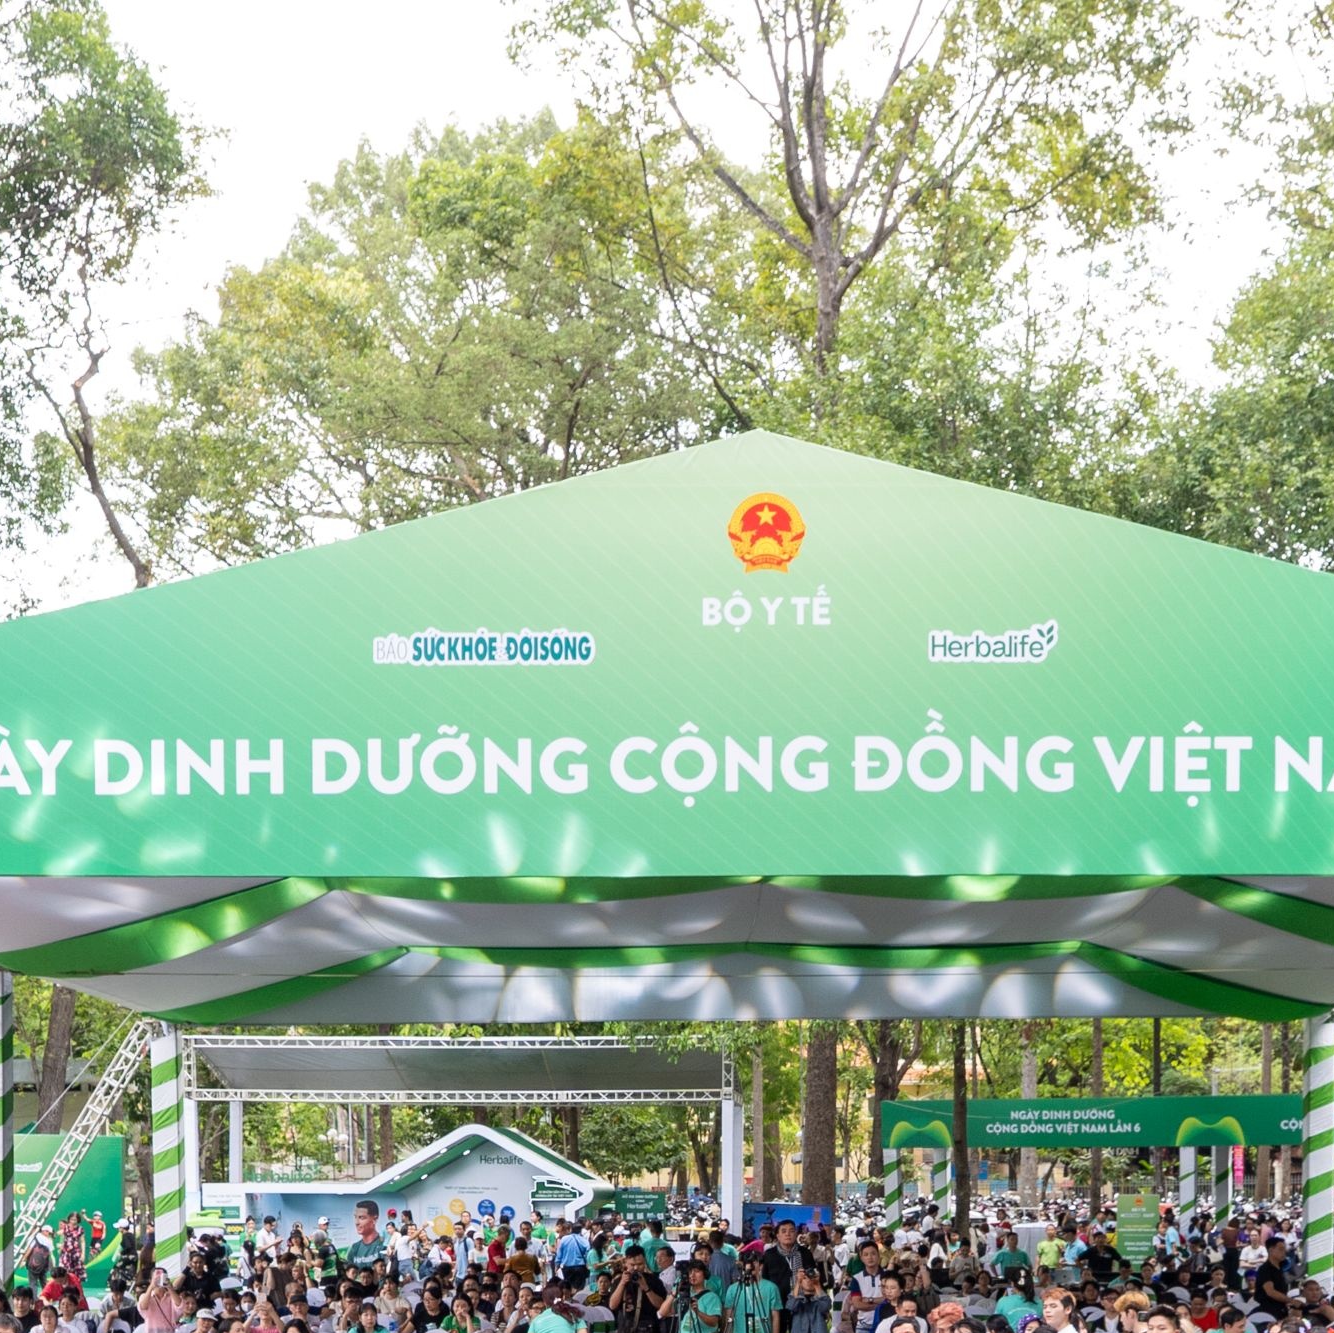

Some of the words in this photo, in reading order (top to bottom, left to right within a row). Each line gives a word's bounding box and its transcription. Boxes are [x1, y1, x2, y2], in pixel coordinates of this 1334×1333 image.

[702, 589, 752, 633] BỘ
[760, 596, 784, 626] Y
[791, 584, 831, 626] TẾ
[931, 634, 1044, 658] Herbalife
[93, 738, 285, 796] DINH
[311, 724, 588, 795] DƯỠNG
[610, 722, 829, 808] CỘNG
[852, 708, 1075, 793] ĐỒNG
[1093, 721, 1253, 808] VIỆT
[1010, 1109, 1040, 1120] NGÀY
[1042, 1110, 1071, 1120] DINH
[1073, 1109, 1115, 1120] DƯỠNG
[986, 1121, 1018, 1136] CỘNG
[1020, 1120, 1054, 1134] ĐỒNG
[1055, 1122, 1079, 1136] VIỆT
[1081, 1123, 1107, 1133] NAM
[1109, 1119, 1132, 1133] LẦN
[1133, 1123, 1141, 1133] 6
[479, 1154, 524, 1166] Herbalife
